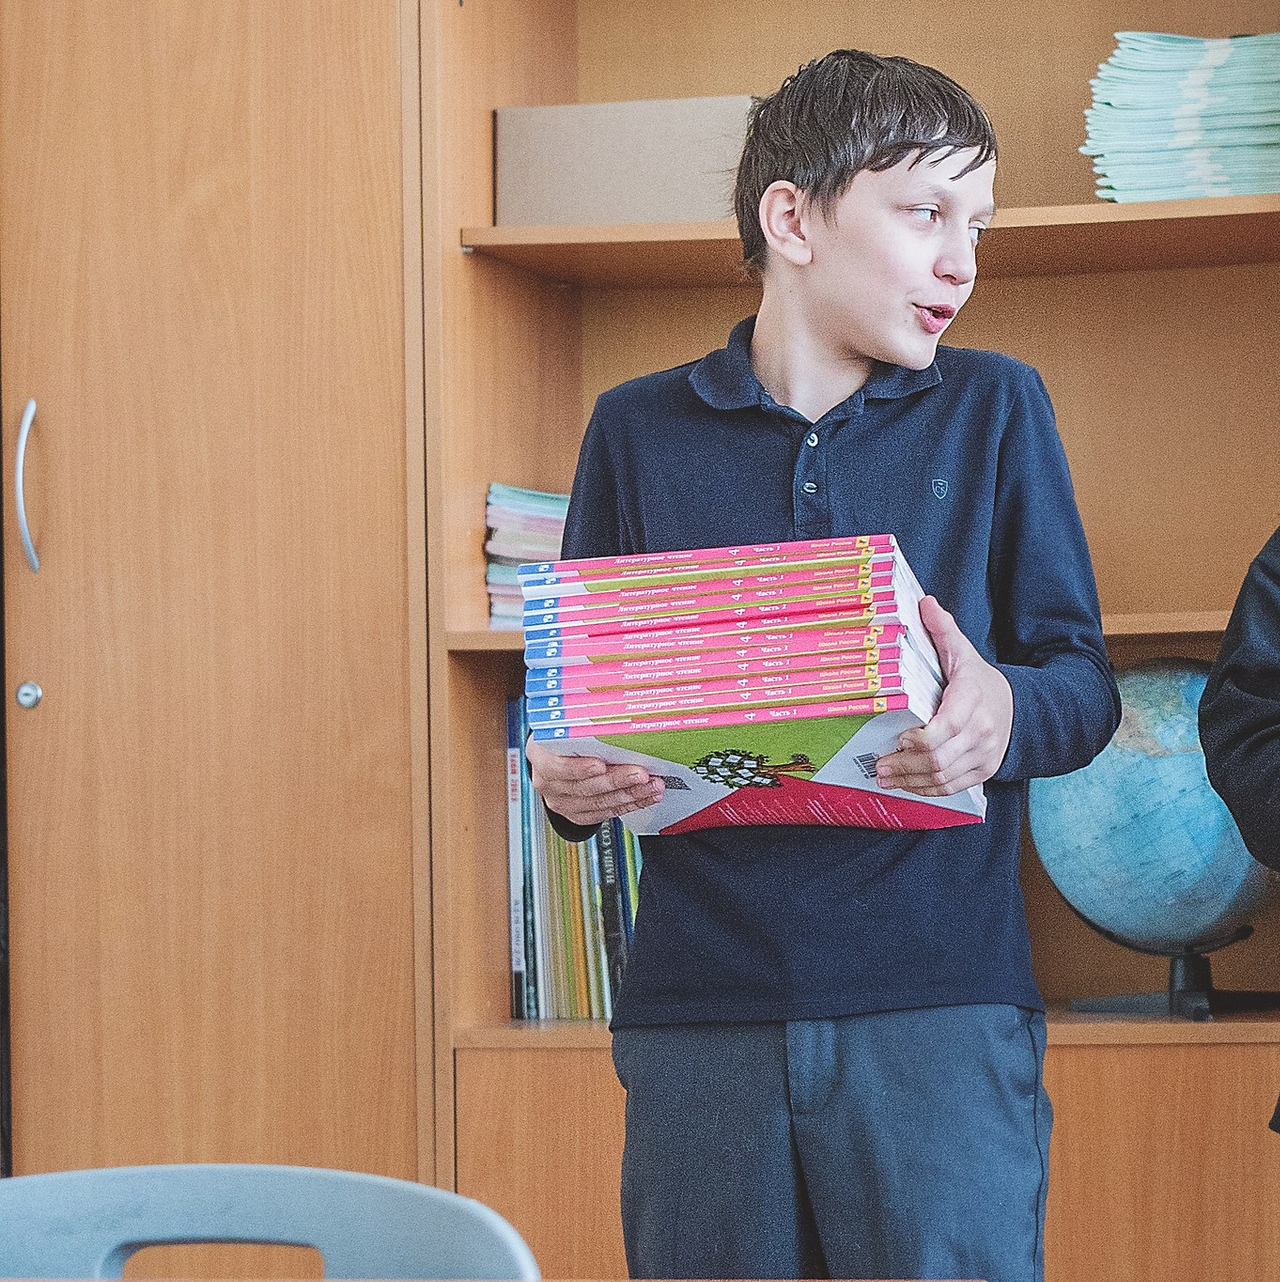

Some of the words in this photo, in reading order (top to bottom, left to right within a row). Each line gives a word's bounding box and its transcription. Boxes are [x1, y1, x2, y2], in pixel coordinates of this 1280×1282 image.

[619, 588, 669, 597] Литературное
[618, 602, 668, 612] Литературное
[621, 618, 671, 627] Литературное
[622, 658, 673, 667] Литературное
[623, 671, 674, 679] Литературное
[623, 688, 674, 696] Литературное
[626, 701, 677, 710] Литературное
[740, 692, 751, 700] 4
